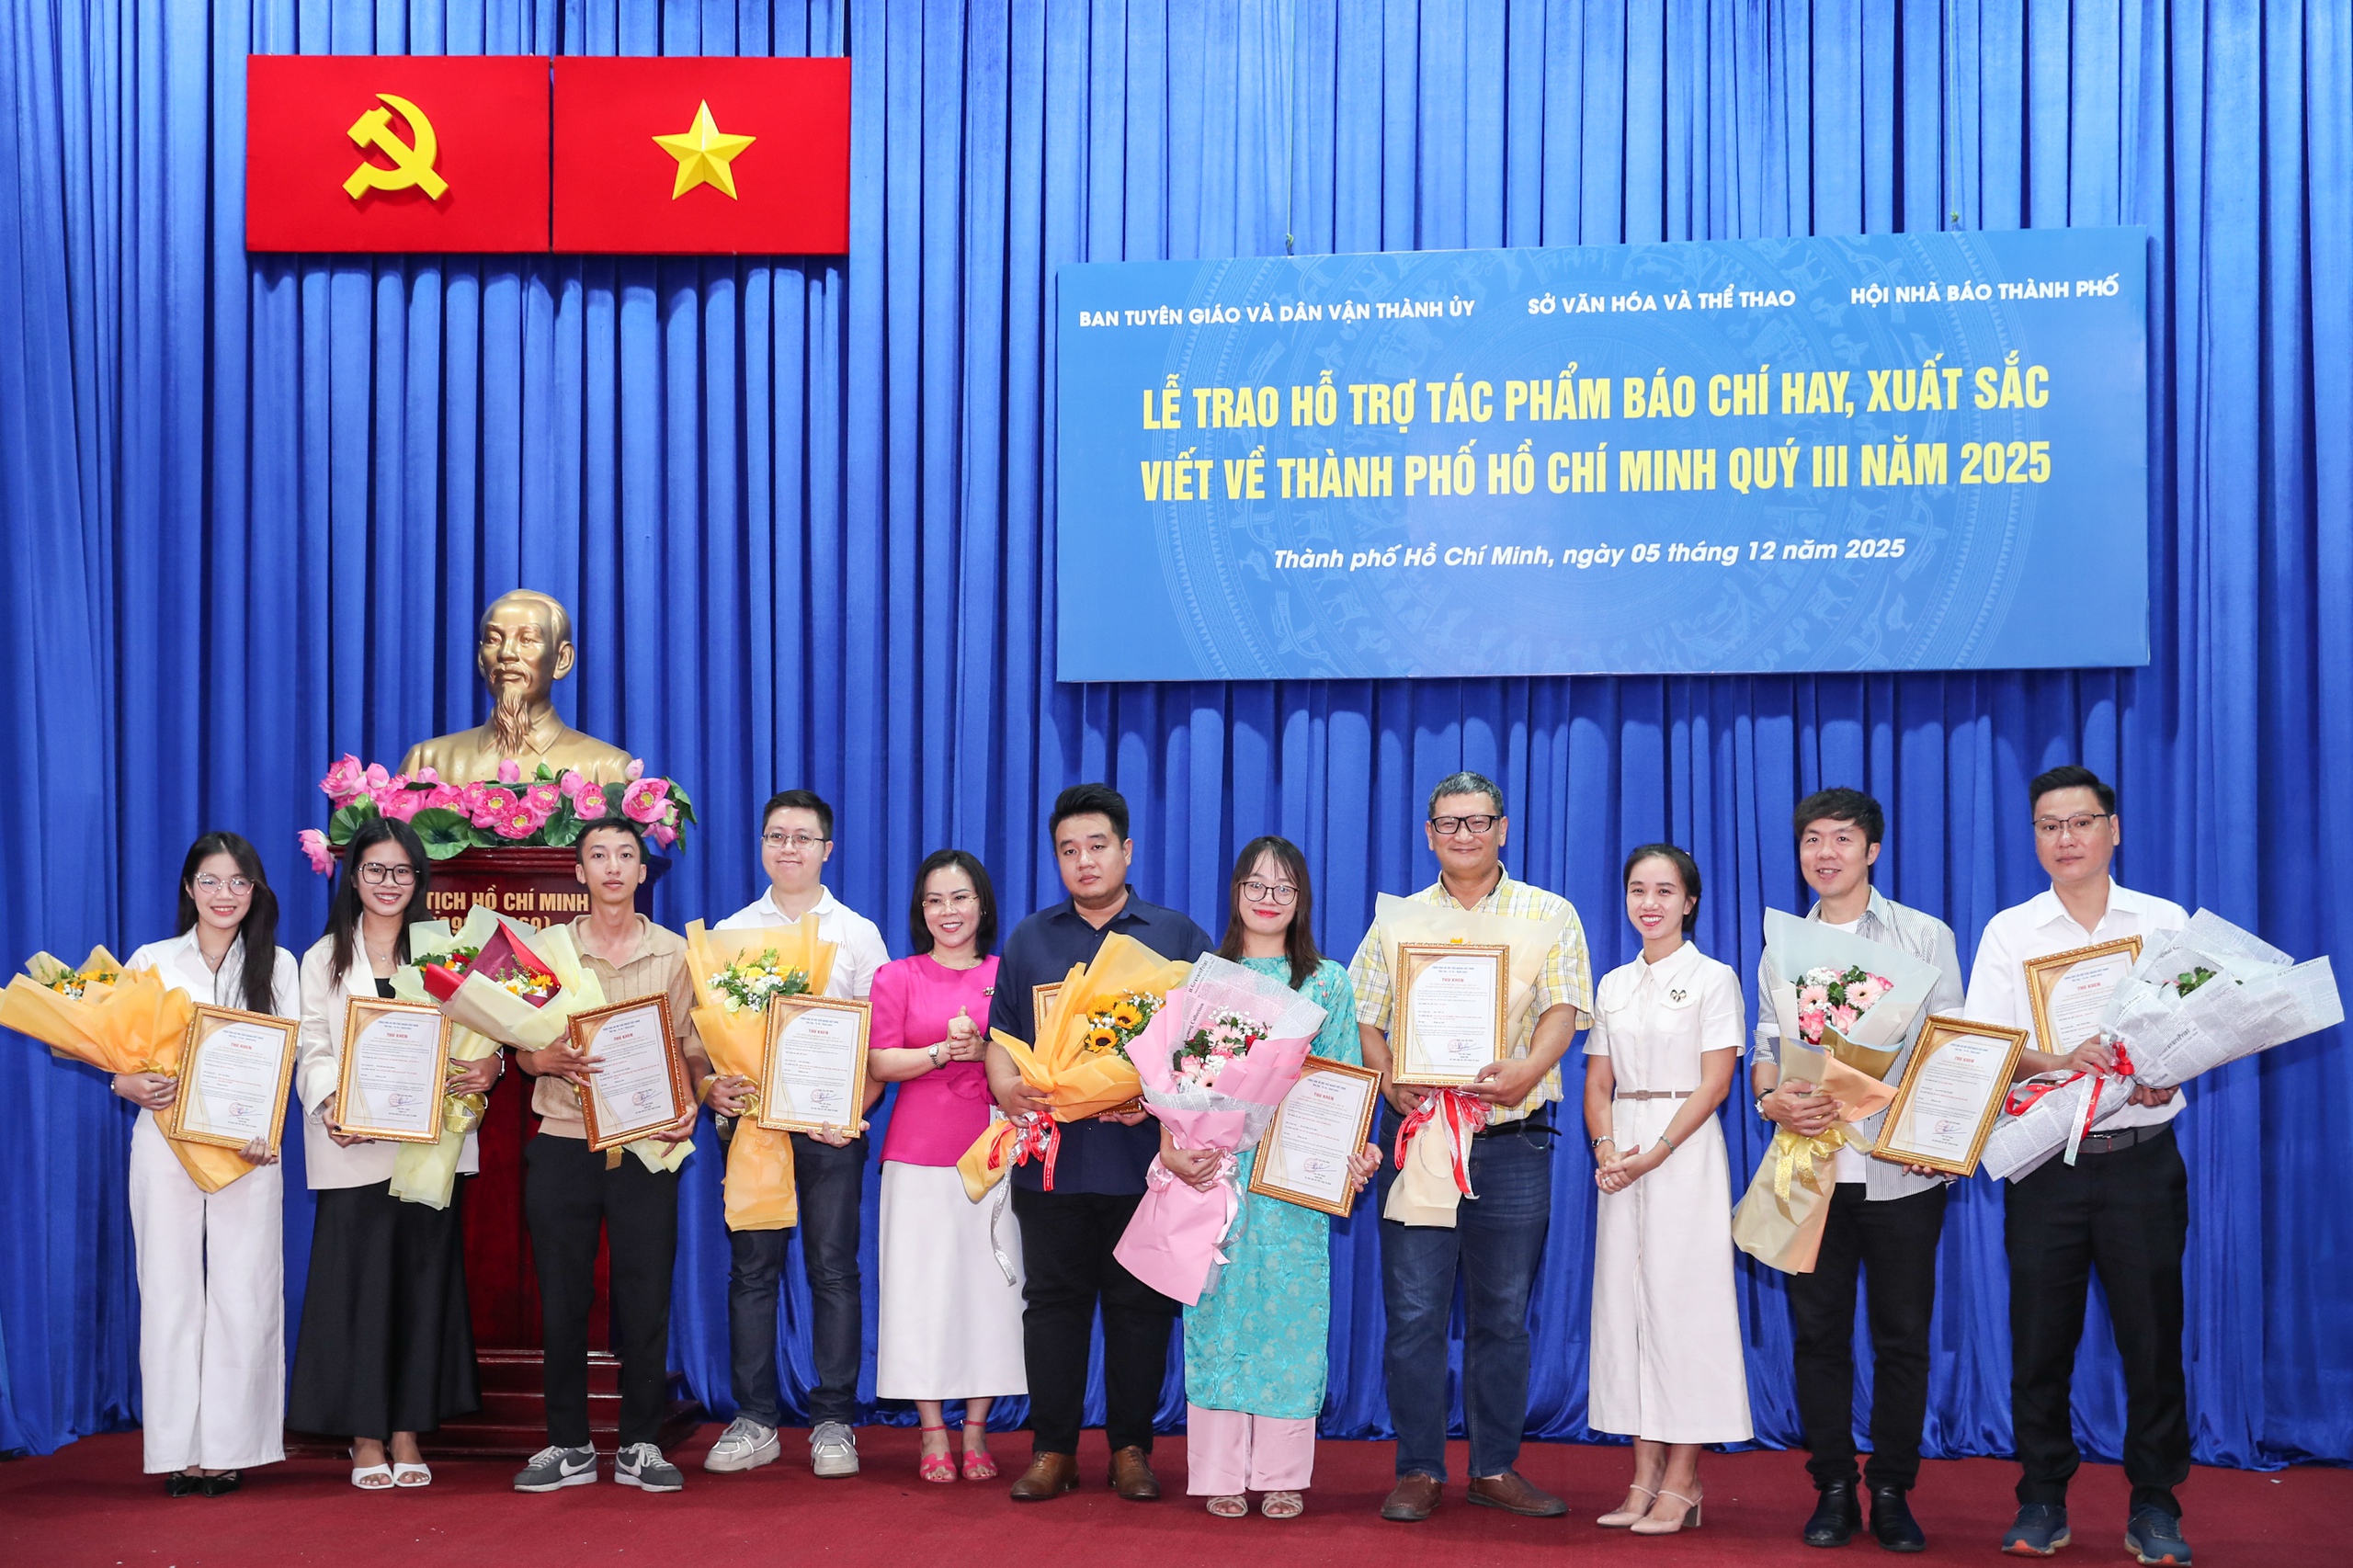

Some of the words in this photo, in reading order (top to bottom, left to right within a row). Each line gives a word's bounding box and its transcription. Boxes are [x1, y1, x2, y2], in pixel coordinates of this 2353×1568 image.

[1528, 291, 1556, 315] SỞ
[1562, 292, 1605, 314] VĂN
[1611, 290, 1657, 312] HÓA
[1663, 289, 1693, 311] VÀ
[1697, 283, 1735, 310] THỂ
[1738, 290, 1796, 308] THAO
[1850, 282, 1889, 309] HỘI
[1895, 280, 1941, 303] NHÀ
[1947, 279, 1993, 301] BÁO
[1997, 278, 2070, 301] THÀNH
[2075, 272, 2120, 298] PHỐ
[1079, 311, 1120, 327] BAN
[1124, 304, 1183, 326] TUYÊN
[1188, 302, 1241, 324] GIÁO
[1245, 301, 1275, 323] VÀ
[1279, 301, 1323, 322] DÂN
[1327, 299, 1370, 324] VẬN
[1375, 297, 1443, 319] THÀNH
[1449, 295, 1475, 317] ỦY
[1143, 372, 1181, 429] LỄ
[1193, 386, 1279, 428] TRAO
[1291, 369, 1337, 426] HỖ
[1348, 379, 1416, 433] TRỢ
[1427, 373, 1493, 423] TÁC
[1506, 361, 1610, 421] PHẨM
[1624, 368, 1696, 418] BÁO
[1709, 365, 1768, 416] CHÍ
[1782, 371, 1854, 417] HAY,
[1868, 353, 1962, 412] XUẤT
[1975, 349, 2049, 409] SẮC
[1141, 447, 1213, 501] VIẾT
[1224, 445, 1265, 499] VỀ
[1277, 449, 1392, 498] THÀNH
[1405, 438, 1475, 495] PHỐ
[1489, 438, 1534, 494] HỒ
[1548, 442, 1607, 494] CHÍ
[1620, 449, 1716, 492] MINH
[1730, 437, 1800, 494] QUÝ
[1813, 446, 1847, 487] III
[1861, 435, 1948, 486] NĂM
[1961, 441, 2051, 483] 2025
[1274, 546, 1345, 569] Thành
[1349, 541, 1403, 573] phố
[1404, 540, 1438, 567] Hồ
[1443, 543, 1488, 567] Chí
[1490, 544, 1554, 568] Minh,
[1562, 542, 1626, 571] ngày
[1631, 542, 1662, 564] 05
[1667, 540, 1741, 567] tháng
[1749, 540, 1778, 562] 12
[1781, 539, 1838, 561] năm
[1844, 538, 1906, 560] 2025
[472, 884, 497, 911] HỒ
[503, 887, 535, 911] CHÍ
[539, 892, 589, 912] MINH
